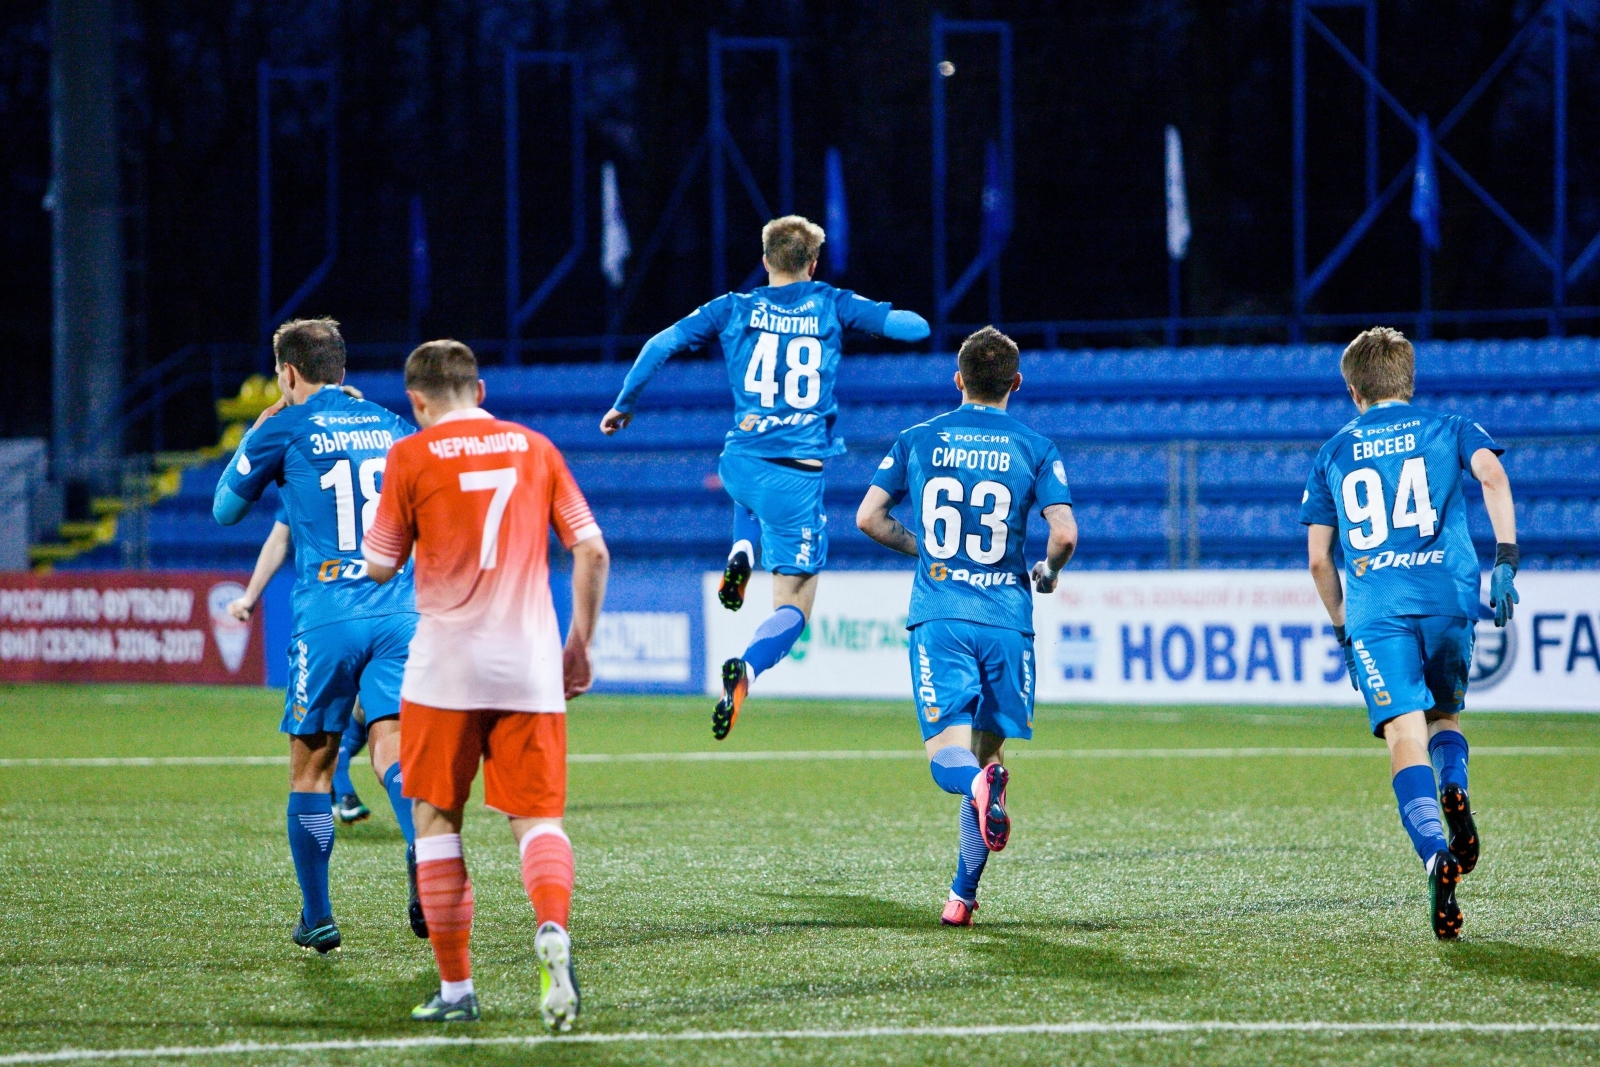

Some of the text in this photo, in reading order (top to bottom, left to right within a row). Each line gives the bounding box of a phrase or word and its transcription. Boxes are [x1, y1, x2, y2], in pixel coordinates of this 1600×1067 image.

[750, 309, 819, 335] БАТЮТИН
[744, 331, 822, 410] 48
[329, 415, 381, 425] РОССИЯ
[1367, 420, 1421, 436] РОССИЯ
[310, 429, 394, 455] ЗЫРЯНОВ
[428, 432, 530, 459] ЧЕРНЫШОВ
[955, 434, 1010, 444] РОССИЯ
[1353, 433, 1416, 461] ЕВСЕЕВ
[932, 447, 1011, 472] СИРОТОВ
[320, 457, 386, 552] 18
[458, 467, 518, 570] 7
[1341, 456, 1438, 550] 94
[922, 476, 1012, 565] 63
[821, 616, 909, 651] Мега
[1533, 612, 1600, 673] FA
[1120, 623, 1347, 682] НОВАТЭ
